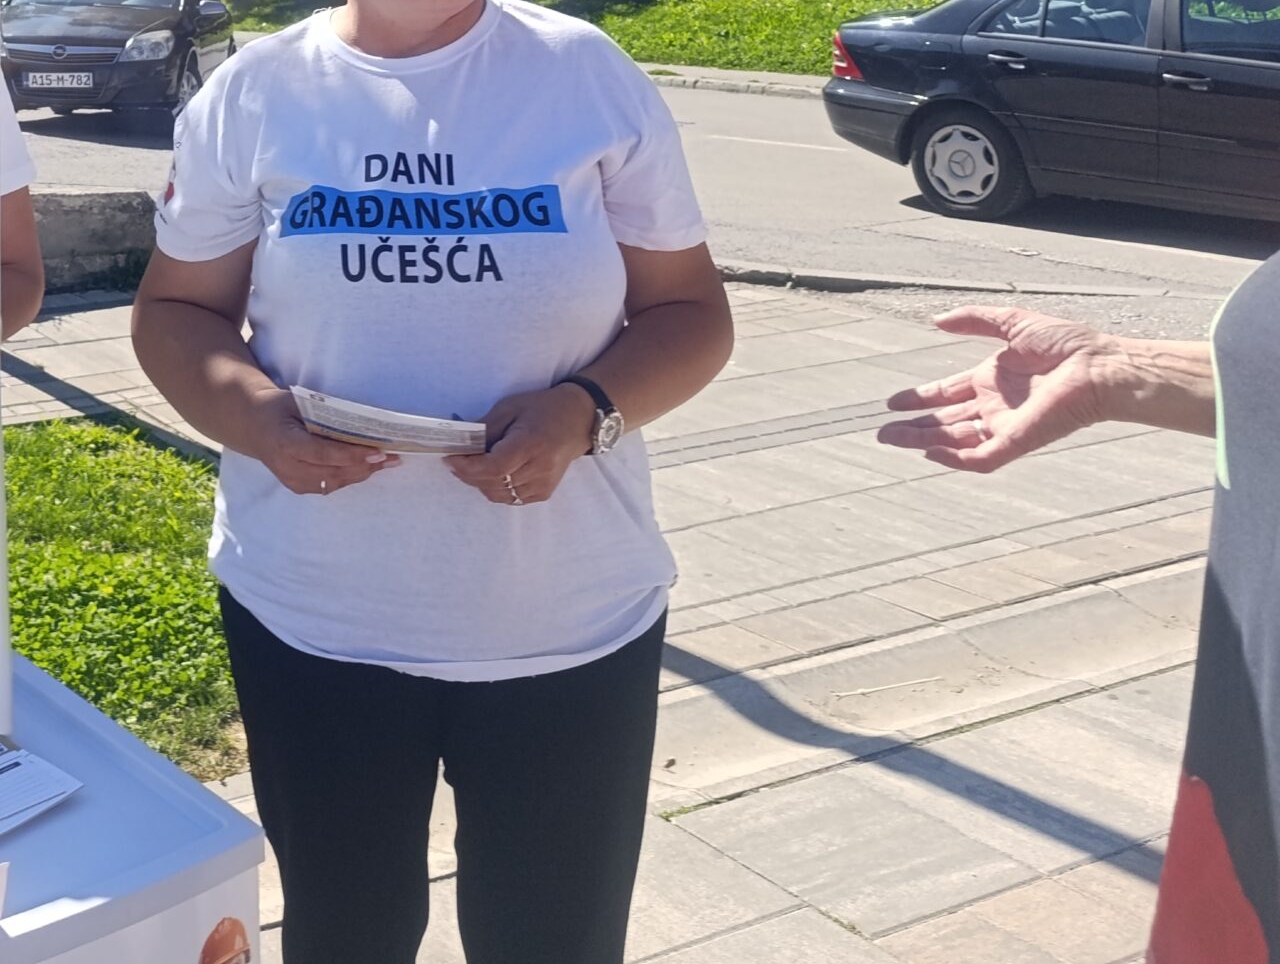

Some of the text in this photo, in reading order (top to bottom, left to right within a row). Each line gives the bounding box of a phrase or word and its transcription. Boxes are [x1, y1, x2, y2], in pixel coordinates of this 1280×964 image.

[31, 74, 91, 86] A15-M-782
[364, 152, 455, 186] DANI
[289, 191, 552, 230] GRAĐANSKOG
[340, 235, 504, 284] UČEŠĆA
